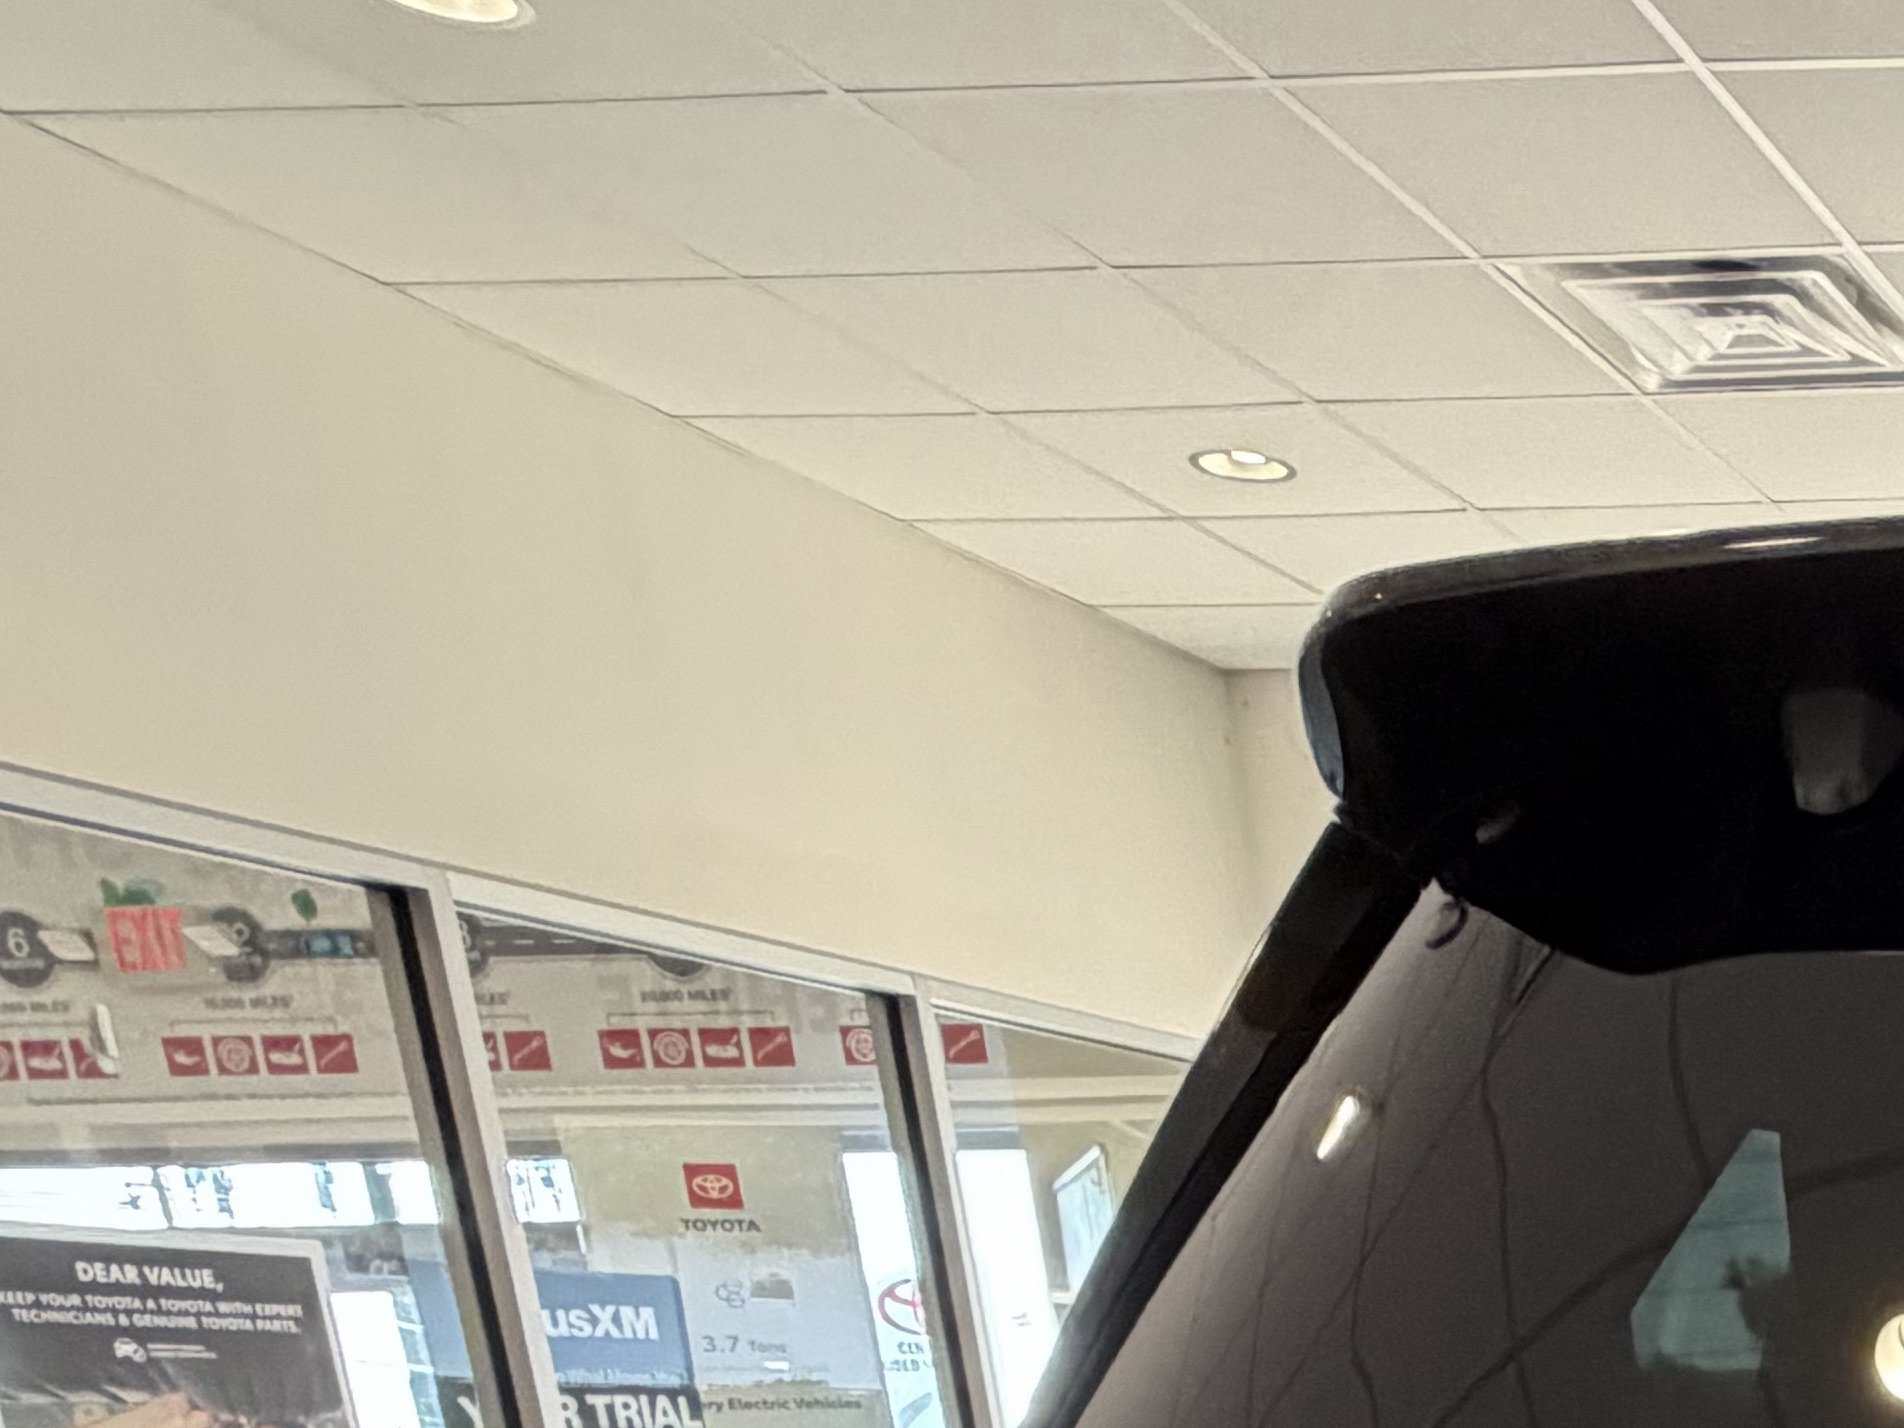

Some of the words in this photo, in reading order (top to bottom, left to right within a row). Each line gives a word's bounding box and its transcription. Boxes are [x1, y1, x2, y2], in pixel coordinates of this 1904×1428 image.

[680, 1217, 762, 1234] TOYOTA
[74, 1261, 142, 1285] DEAR
[143, 1265, 225, 1293] VALUE,
[39, 1293, 83, 1308] YOUR
[84, 1294, 142, 1310] TOYOTA
[159, 1297, 215, 1314] TOYOTA
[11, 1308, 116, 1326] TECHNICIANS
[201, 1316, 253, 1331] TOYOTA
[542, 1304, 660, 1342] usXM
[701, 1334, 740, 1353] 3.7
[728, 1397, 791, 1411] Electric
[793, 1396, 862, 1410] Vehicles
